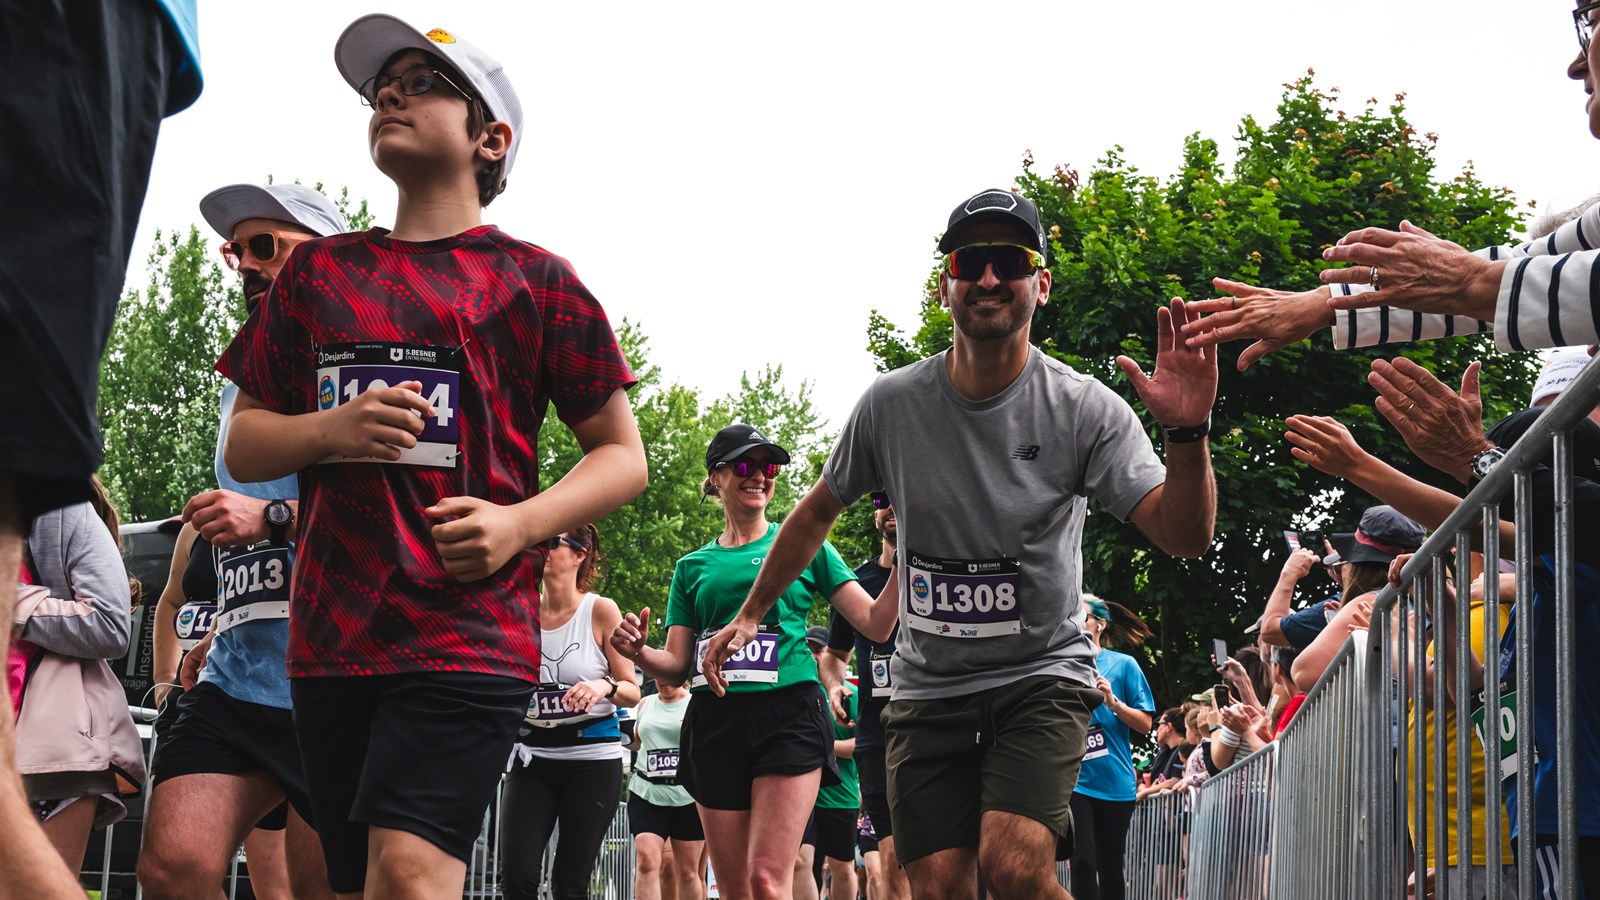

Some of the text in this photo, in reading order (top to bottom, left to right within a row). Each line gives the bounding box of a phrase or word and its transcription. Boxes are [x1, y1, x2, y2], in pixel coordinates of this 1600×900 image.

[325, 351, 355, 363] Desjardins
[405, 348, 437, 358] S.BESNER
[344, 378, 453, 427] 14
[917, 559, 943, 571] Desjardins
[224, 558, 285, 601] 2013
[936, 583, 1016, 613] 1308
[136, 604, 156, 677] inscription
[725, 639, 776, 663] 307
[1086, 733, 1105, 750] 69
[657, 756, 680, 768] 105
